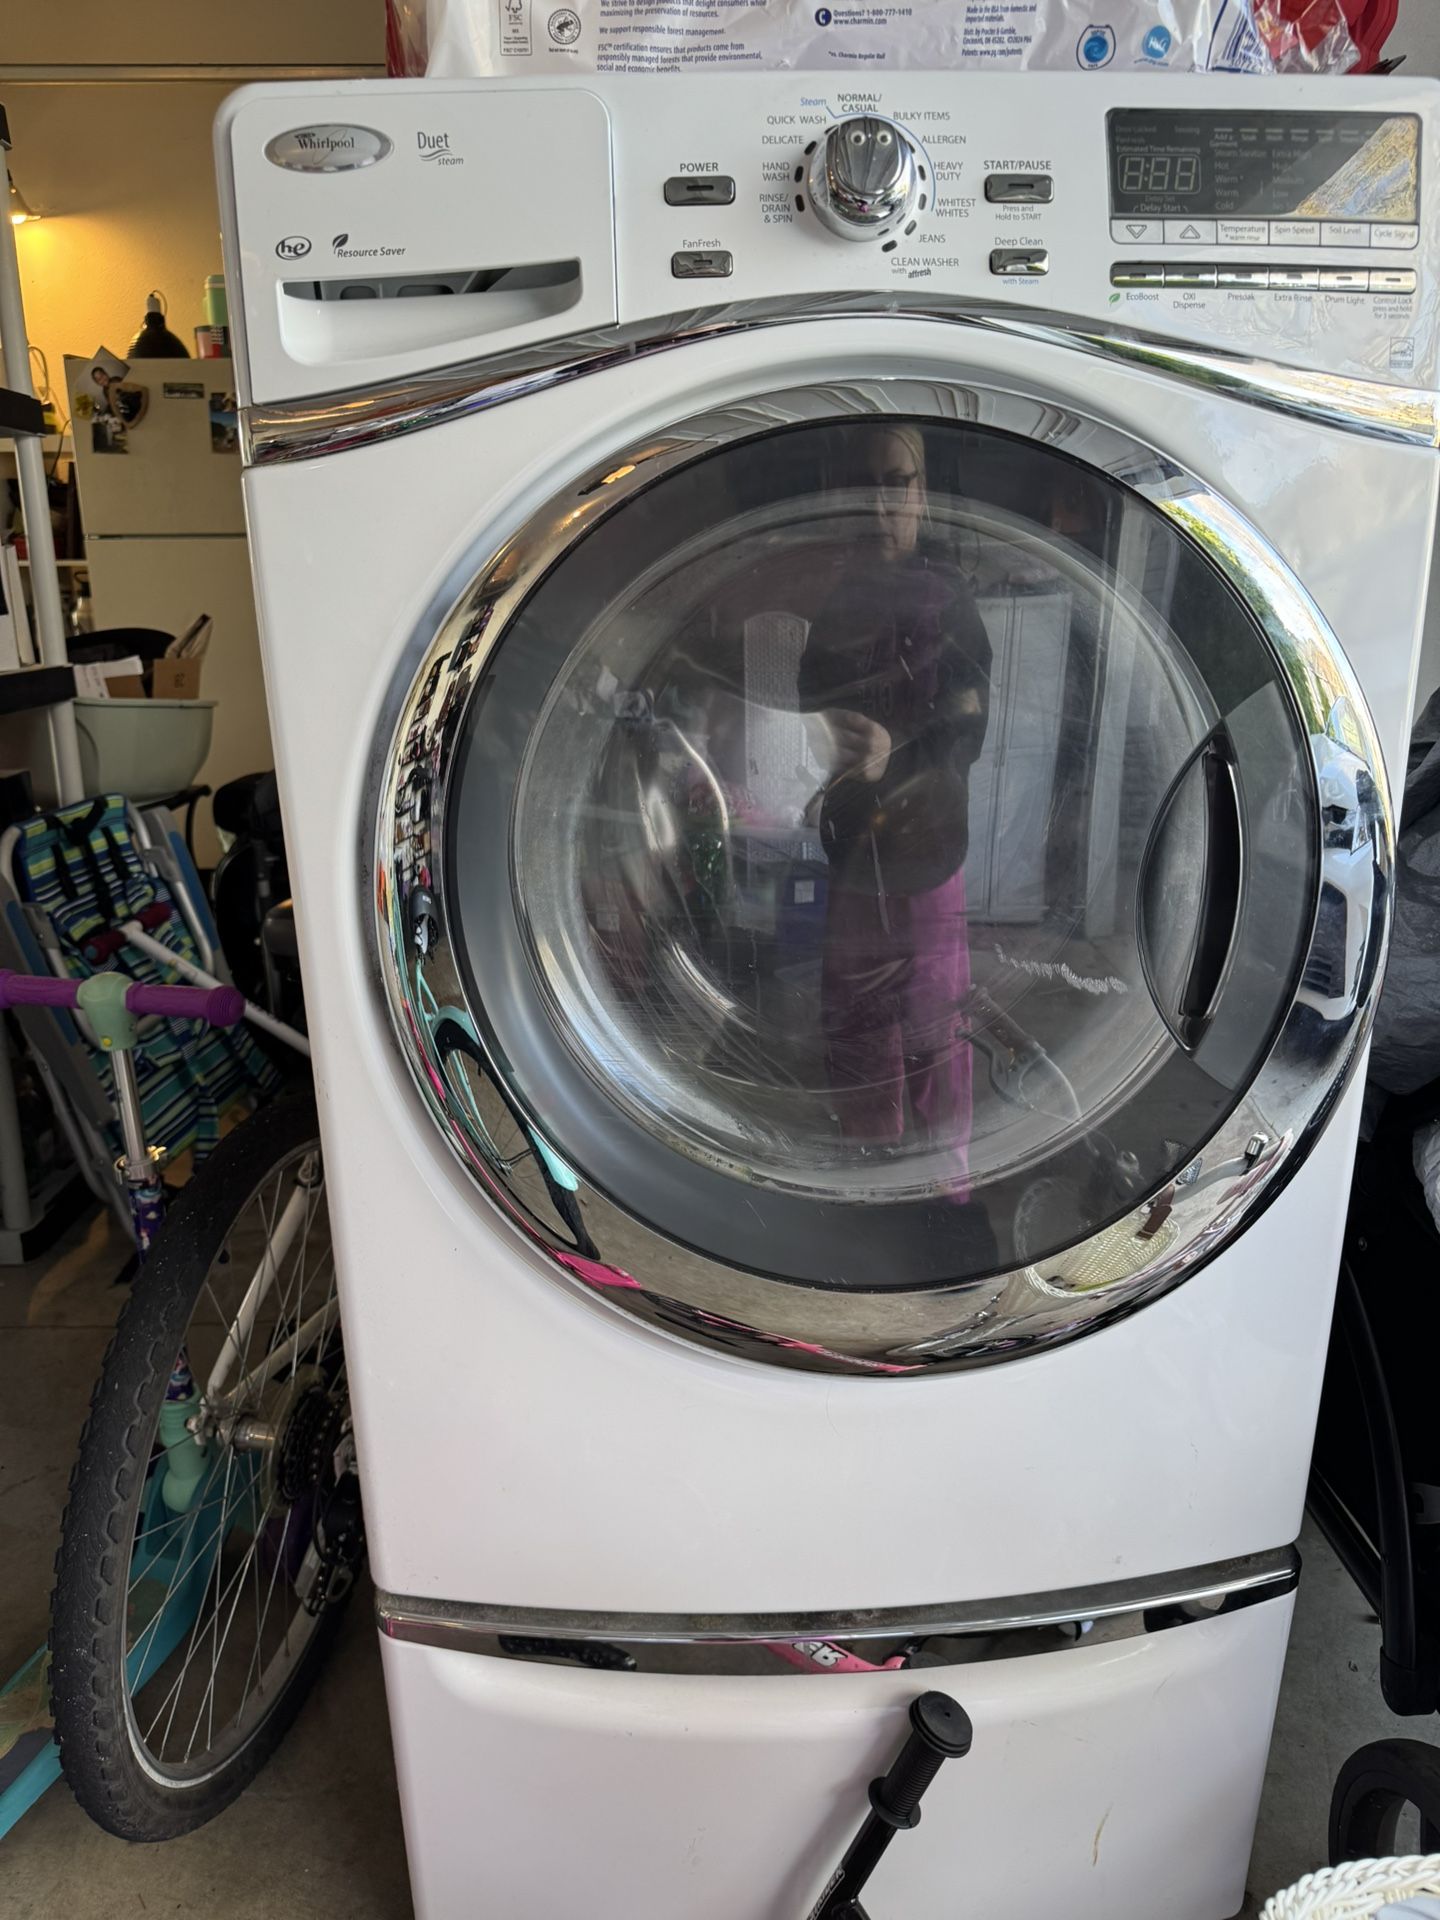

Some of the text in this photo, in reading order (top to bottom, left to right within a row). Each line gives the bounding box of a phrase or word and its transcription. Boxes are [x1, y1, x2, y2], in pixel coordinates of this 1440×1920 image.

[634, 8, 644, 16] the
[645, 7, 681, 16] preservation
[682, 8, 688, 16] of
[690, 10, 719, 18] resources.
[833, 9, 865, 17] Questions?
[833, 17, 887, 25] www.charmin.com
[600, 25, 726, 37] We support responsible forest management.
[613, 43, 648, 51] certification
[649, 45, 673, 53] ensures
[673, 46, 686, 54] that
[686, 45, 712, 55] products
[730, 42, 745, 50] from
[597, 53, 630, 63] responsibly
[631, 55, 659, 64] managed
[660, 55, 680, 64] forests
[695, 53, 717, 64] provide
[718, 51, 763, 61] environmental,
[838, 51, 857, 59] Charmin
[597, 63, 614, 71] social
[615, 63, 627, 72] and
[627, 65, 656, 73] economic
[800, 97, 827, 107] Steam
[837, 93, 882, 103] NORMAL/
[842, 103, 879, 113] CASUAL
[767, 115, 827, 126] QUICK WASH
[892, 111, 951, 121] BULKY ITEMS
[297, 137, 355, 152] Whirlpool
[417, 131, 451, 150] Duet
[762, 135, 804, 145] DELICATE
[921, 135, 967, 145] ALLERGEN
[1117, 145, 1201, 155] Estimated Time Remaining
[437, 156, 464, 166] steam
[983, 160, 1052, 171] START/PAUSE
[679, 162, 720, 173] POWER
[762, 161, 790, 172] HAND
[933, 161, 964, 172] HEAVY
[762, 172, 790, 182] WASH
[936, 172, 961, 182] DUTY
[1214, 175, 1239, 184] Warm
[1214, 188, 1240, 198] Warm
[759, 193, 789, 204] RINSE/
[937, 197, 977, 207] WHITEST
[761, 204, 791, 215] DRAIN
[1002, 204, 1034, 213] Press and
[1140, 203, 1181, 214] Delay Start
[1214, 200, 1235, 211] Cold
[935, 208, 969, 219] WHITES
[995, 212, 1042, 221] Hold to START
[764, 215, 793, 225] & SPIN
[1220, 223, 1266, 234] Temperature
[1274, 225, 1314, 236] Spin Speed
[1329, 226, 1343, 234] Soil
[1373, 228, 1393, 239] Cycle
[682, 238, 721, 249] FanFresh
[919, 234, 947, 245] JEANS
[994, 236, 1043, 248] Deep Clean
[337, 246, 407, 259] Resource Saver
[890, 257, 960, 268] CLEAN WASHER
[891, 267, 932, 279] with affresh
[1002, 277, 1040, 286] with Steam
[1126, 292, 1159, 301] EcoBoost
[1182, 292, 1196, 301] OXI
[1227, 293, 1255, 301] Presoak
[1274, 293, 1313, 303] Extra Rinse
[1324, 295, 1365, 306] Drum Light
[1373, 296, 1397, 305] Control
[1173, 300, 1206, 311] Dispense
